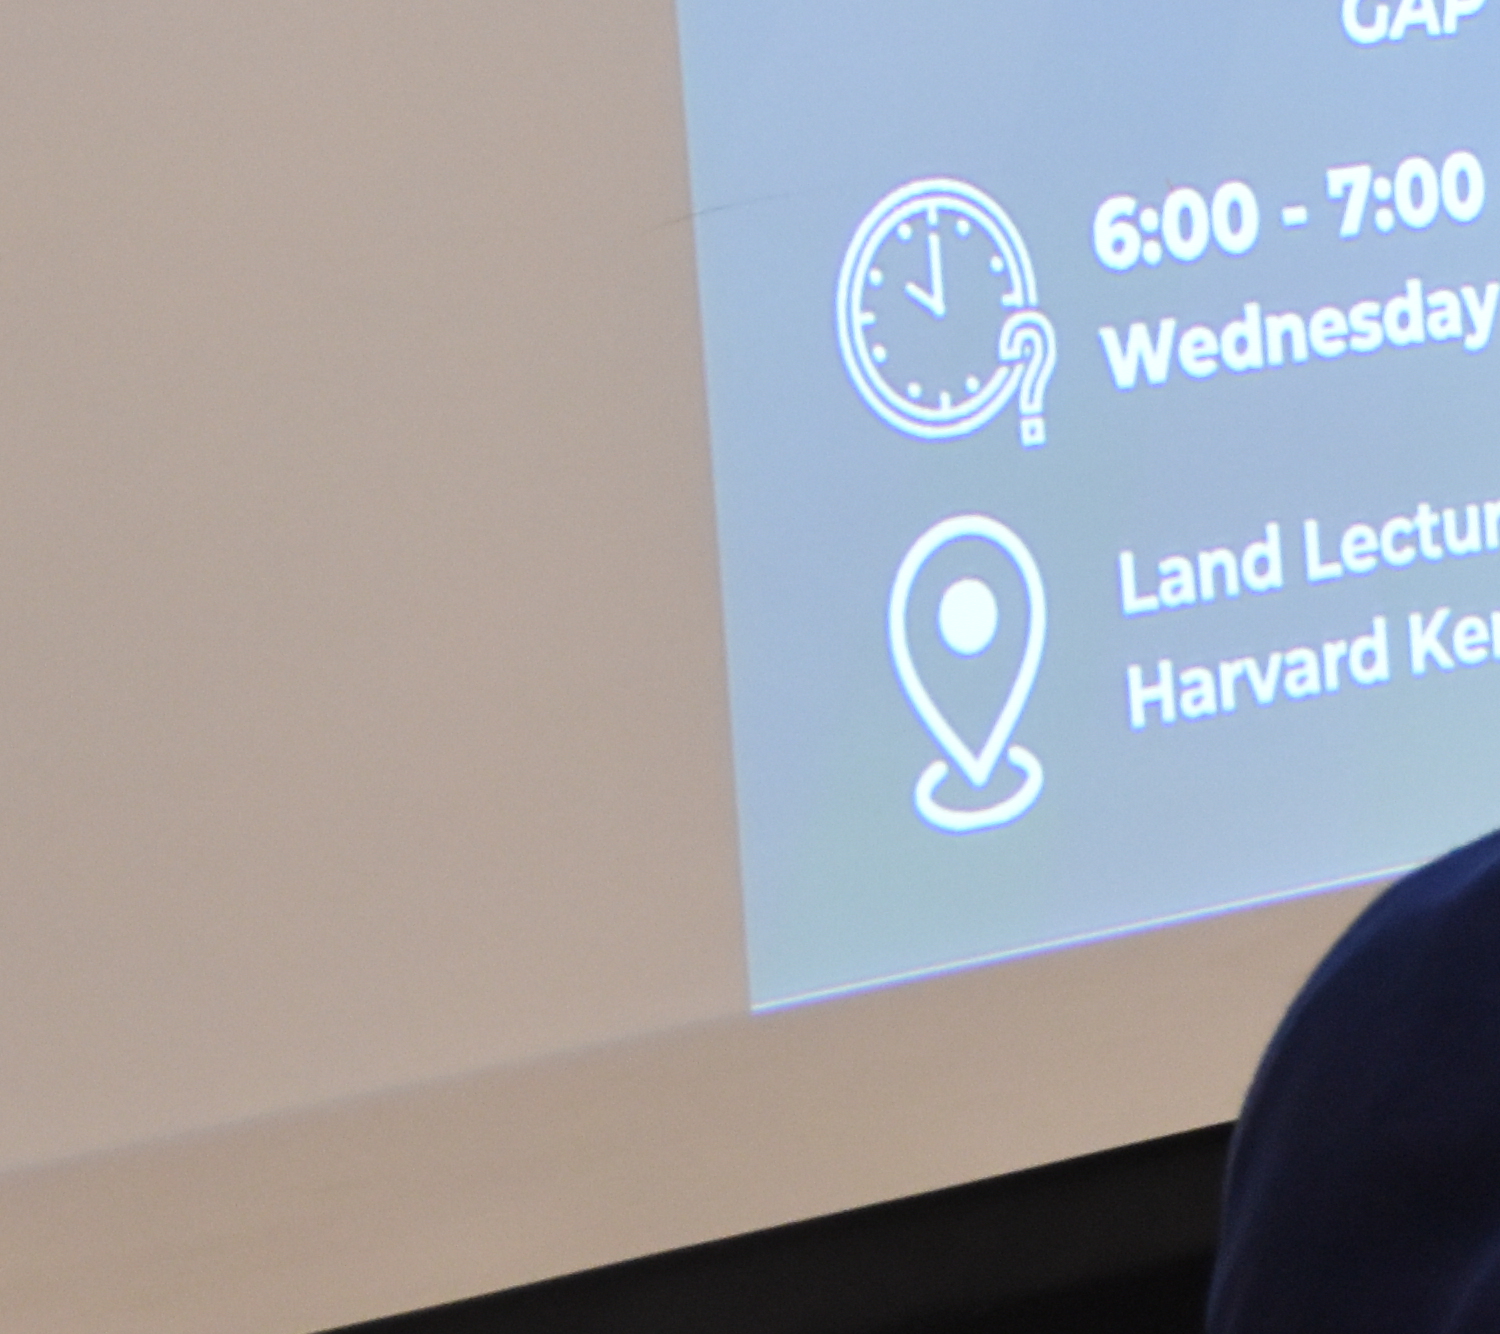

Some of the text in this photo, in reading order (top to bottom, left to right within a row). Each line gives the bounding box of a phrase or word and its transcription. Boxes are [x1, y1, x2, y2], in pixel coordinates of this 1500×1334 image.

[1093, 180, 1259, 268] 6:00
[1282, 205, 1308, 223] -
[1326, 150, 1485, 234] 7:00
[1099, 277, 1500, 386] Wednesday
[1120, 521, 1283, 611] Land
[1128, 615, 1389, 725] Harvard
